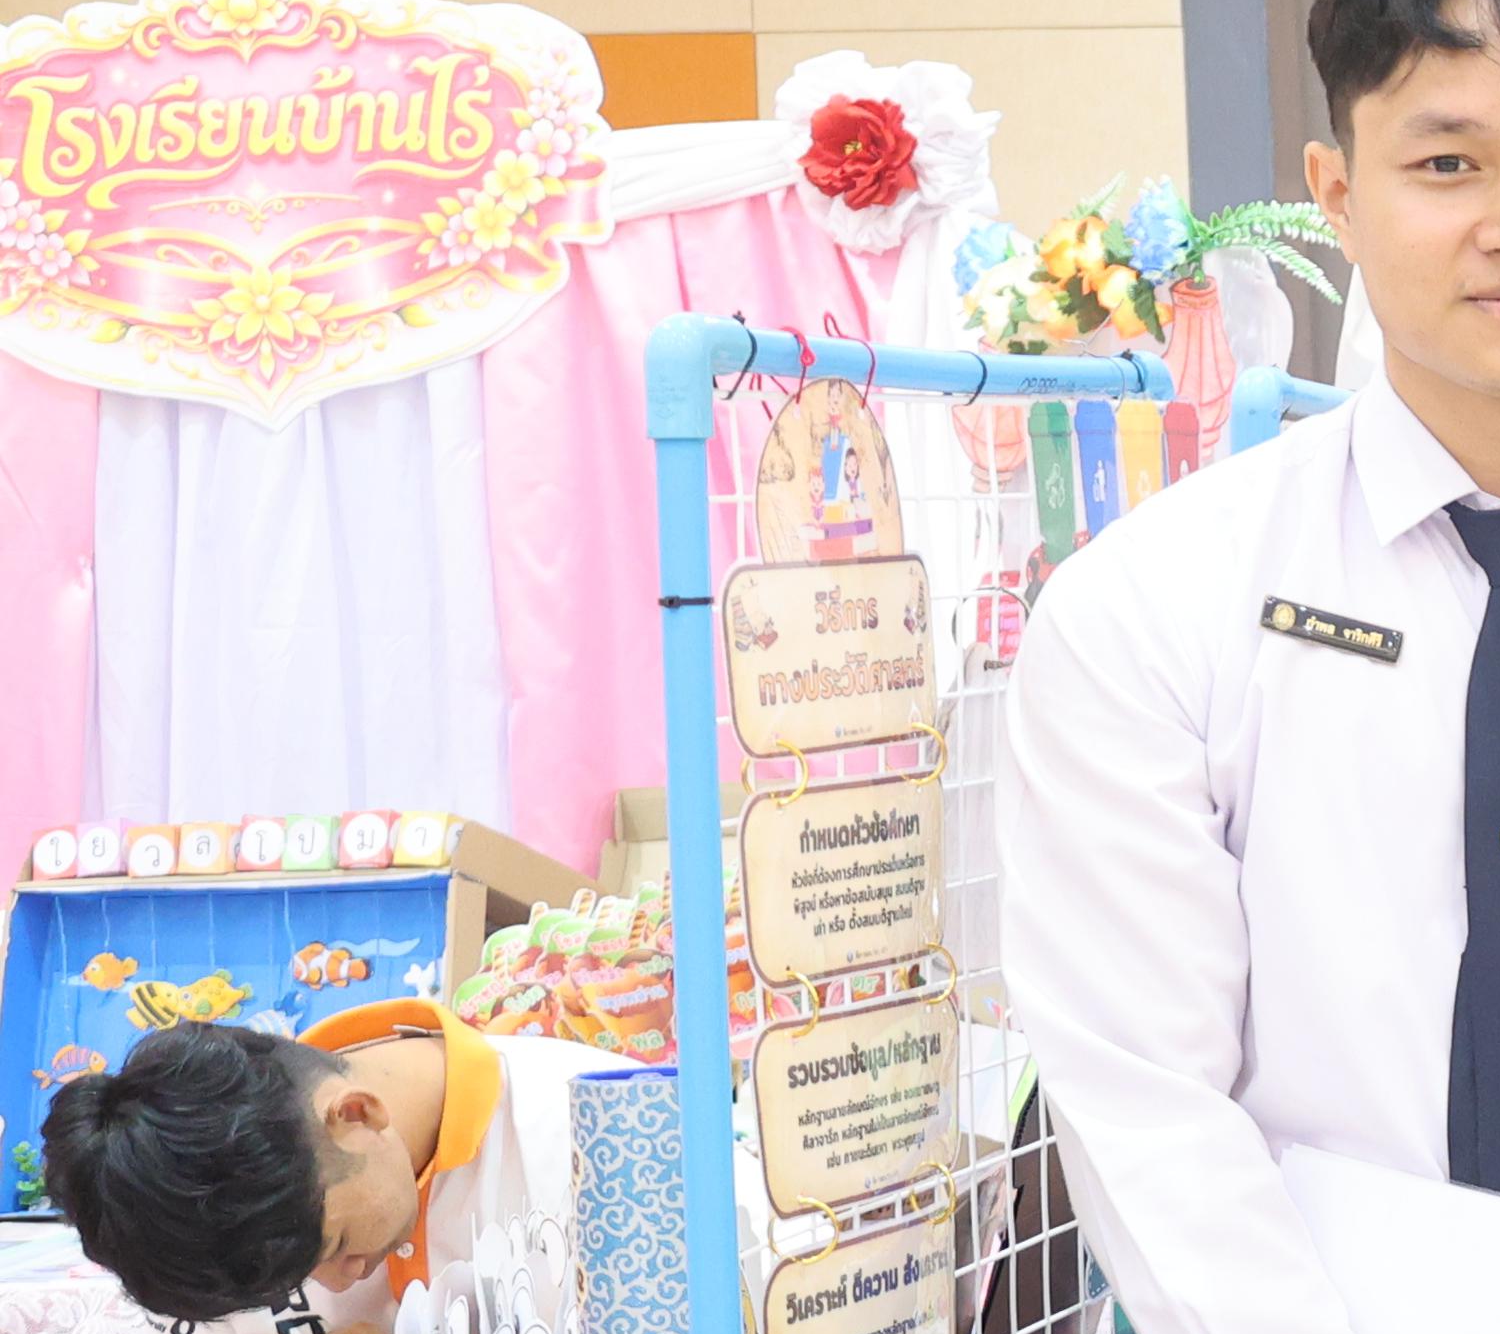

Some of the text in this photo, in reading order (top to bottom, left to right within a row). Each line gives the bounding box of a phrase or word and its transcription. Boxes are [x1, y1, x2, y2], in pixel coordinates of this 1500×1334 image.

[8, 56, 496, 207] โรงเรียนบ้านไร่
[815, 586, 879, 634] วิธีการ
[800, 808, 920, 854] กำหนดหัวข้อศึกษา
[829, 914, 845, 933] หรือ
[788, 1031, 942, 1089] รวบรวมข้อมูล/หลักฐาน
[786, 1275, 848, 1325] วิเคราะห์
[852, 1268, 899, 1303] ตีความ
